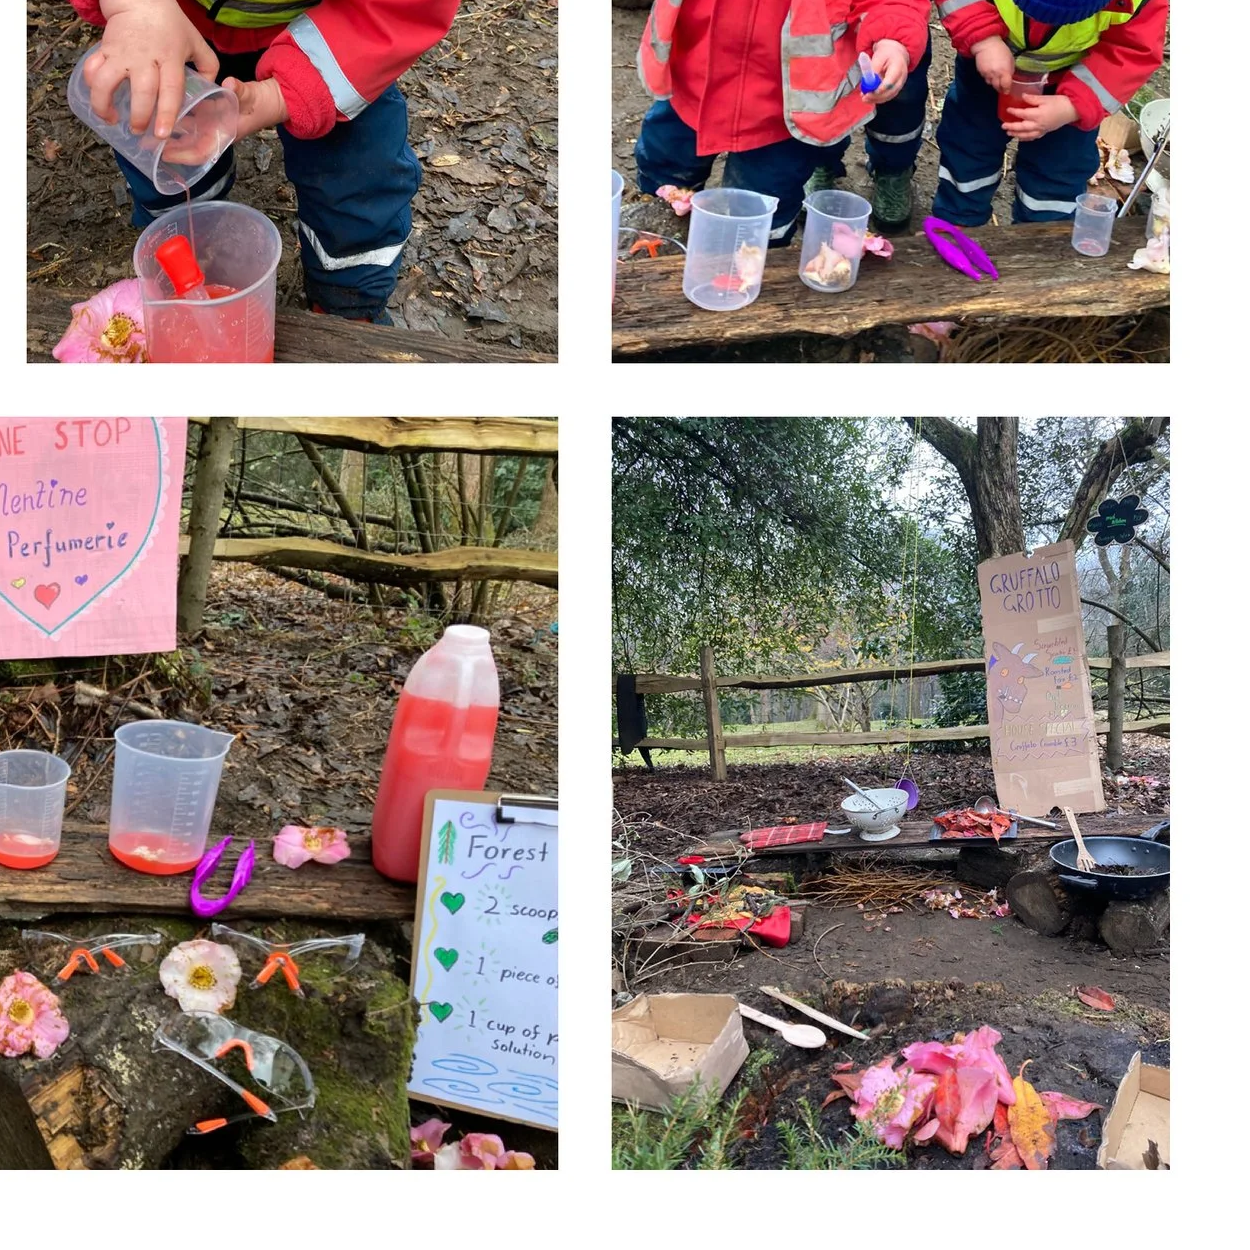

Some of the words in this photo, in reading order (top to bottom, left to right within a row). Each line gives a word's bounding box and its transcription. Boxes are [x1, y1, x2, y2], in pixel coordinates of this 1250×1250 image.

[54, 417, 132, 450] STOP
[7, 522, 129, 568] Perfumerie
[990, 561, 1061, 594] GRUFFALO
[1003, 586, 1061, 614] GROTTO
[468, 835, 549, 862] Forest
[484, 896, 500, 914] 2
[476, 956, 485, 976] 1
[500, 965, 540, 983] piece
[468, 1010, 476, 1028] 1
[486, 1020, 516, 1036] cup
[522, 1024, 541, 1040] of
